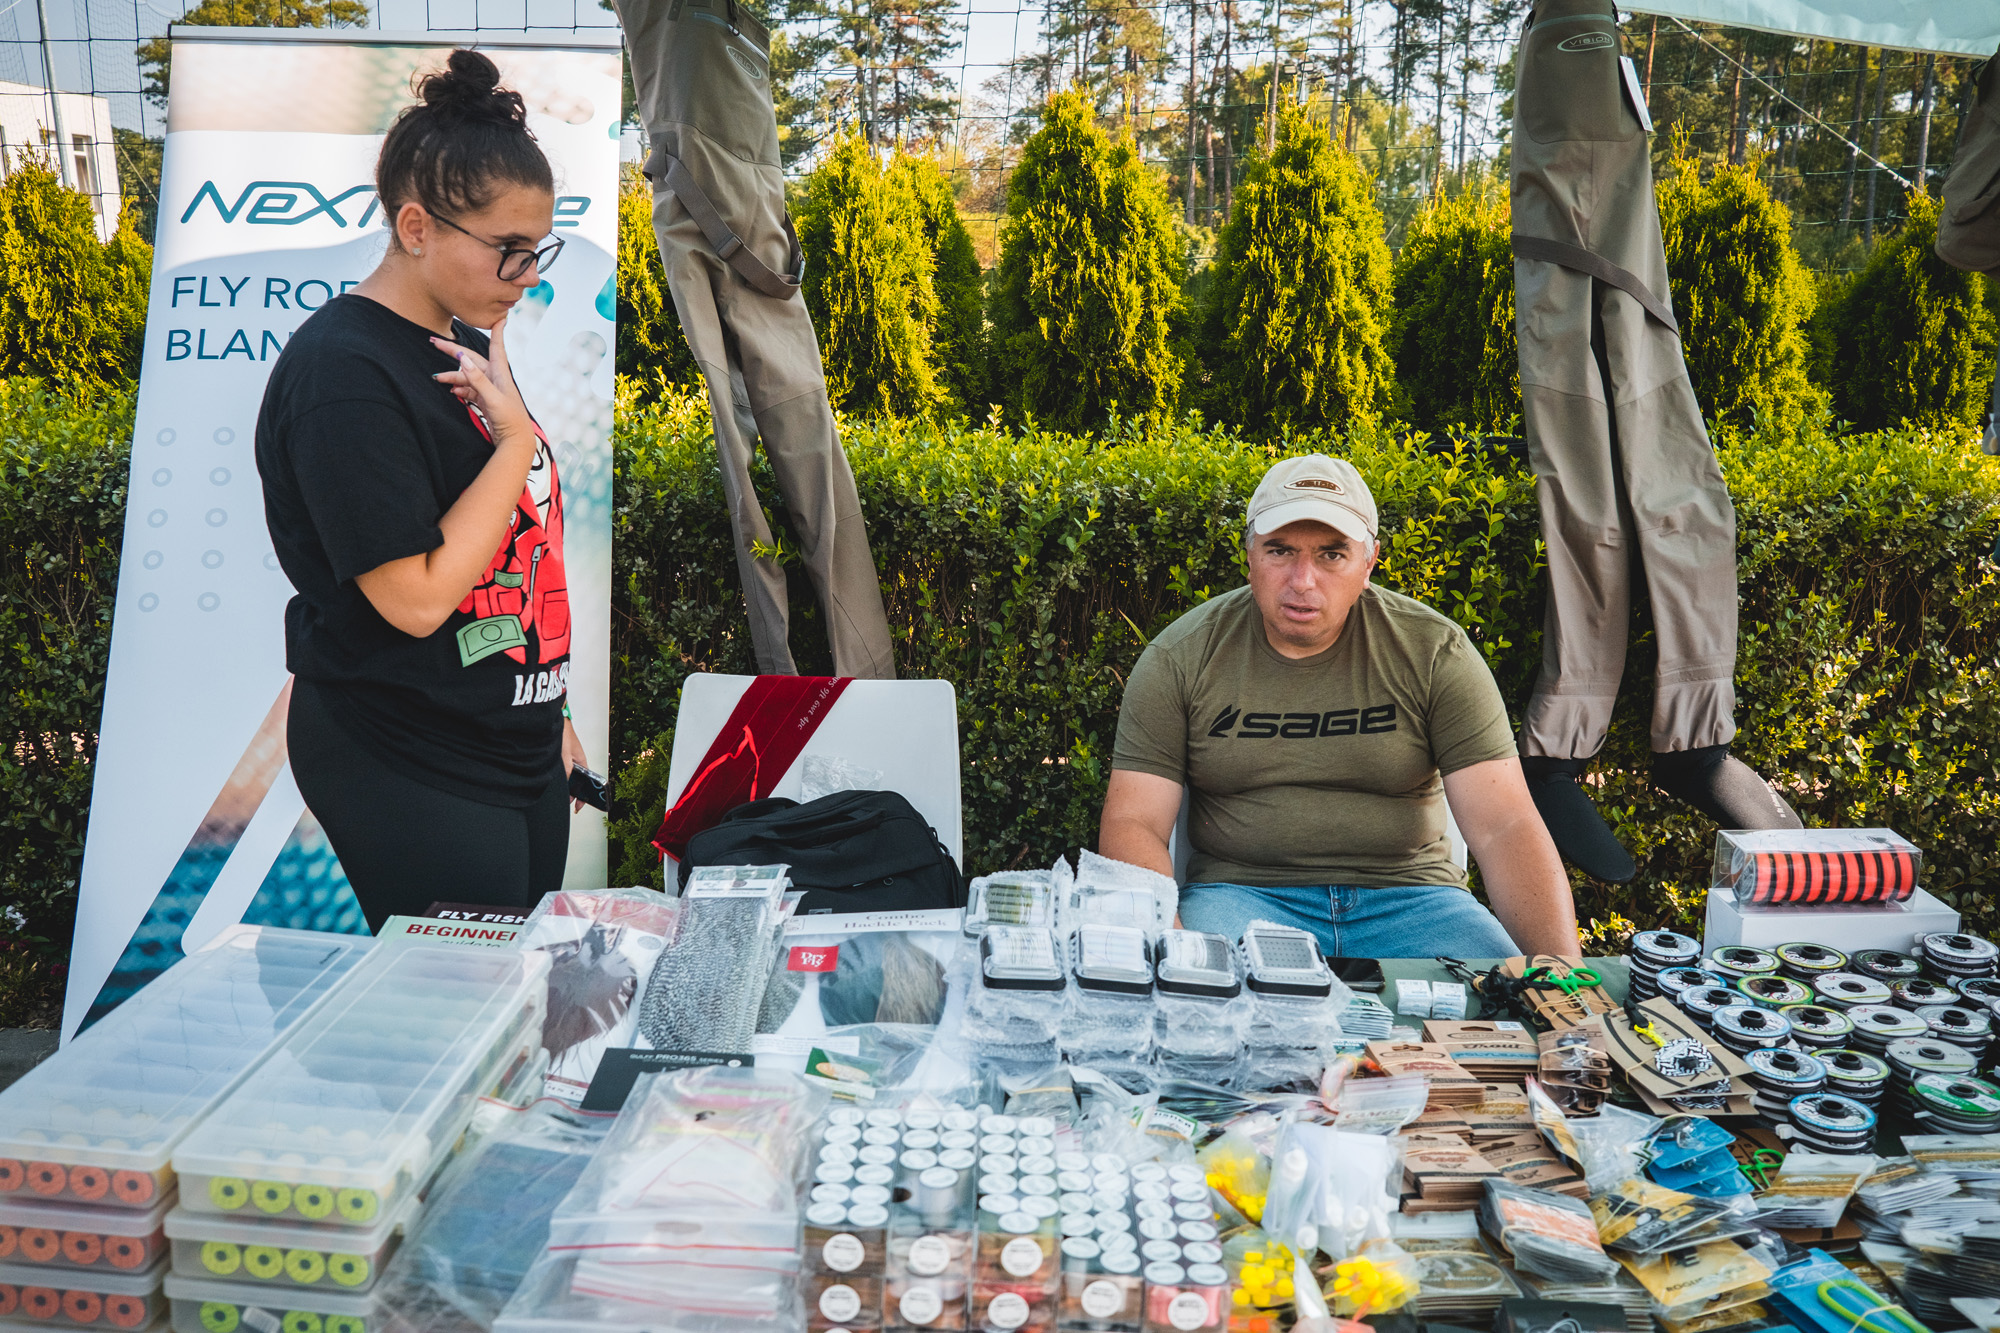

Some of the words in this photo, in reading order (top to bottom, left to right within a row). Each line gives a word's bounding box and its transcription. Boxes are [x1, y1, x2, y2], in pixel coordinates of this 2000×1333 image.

[1568, 33, 1613, 49] VISION
[171, 276, 251, 308] FLY
[166, 328, 296, 361] BLAN
[511, 674, 535, 706] LA
[437, 910, 479, 921] FLY
[866, 912, 927, 922] Combo
[655, 1053, 698, 1063] PRO365
